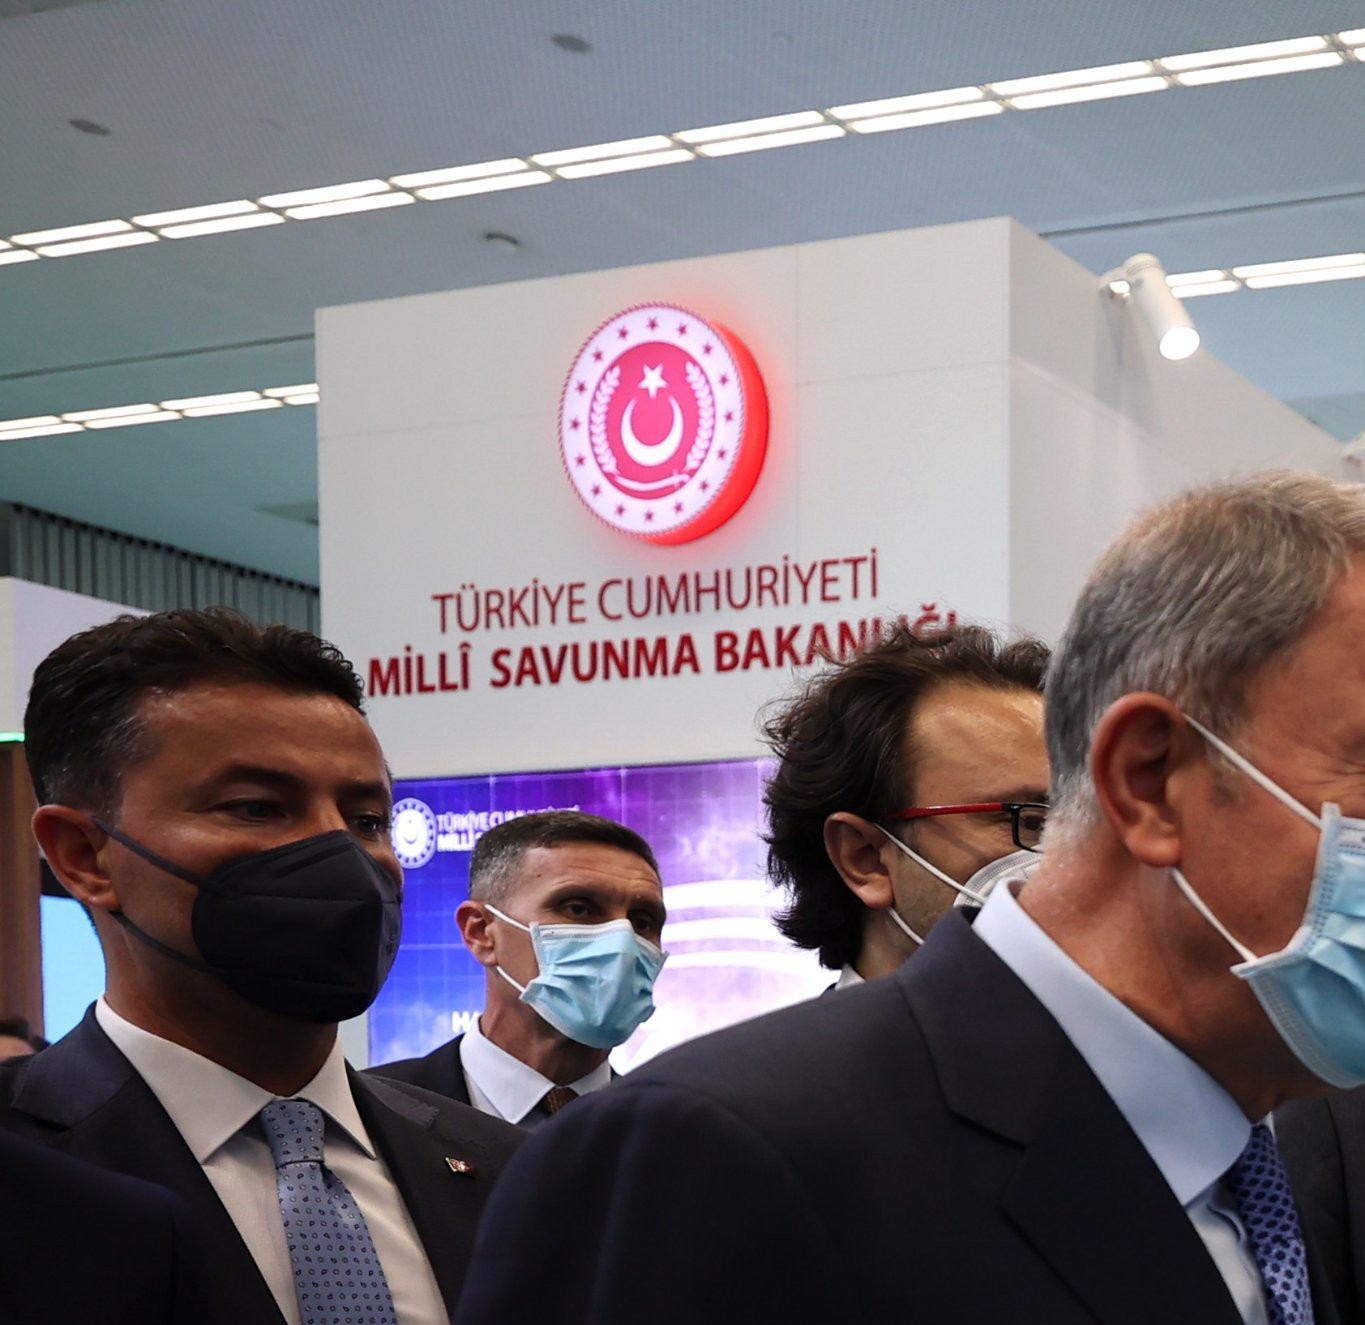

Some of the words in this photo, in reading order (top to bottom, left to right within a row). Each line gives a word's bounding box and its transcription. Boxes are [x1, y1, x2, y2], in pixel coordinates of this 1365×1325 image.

[432, 577, 587, 634] TÜRKİYE
[597, 547, 880, 620] CUMHURİYETİ
[367, 633, 472, 698] MİLLÎ
[488, 631, 701, 689] SAVUNMA
